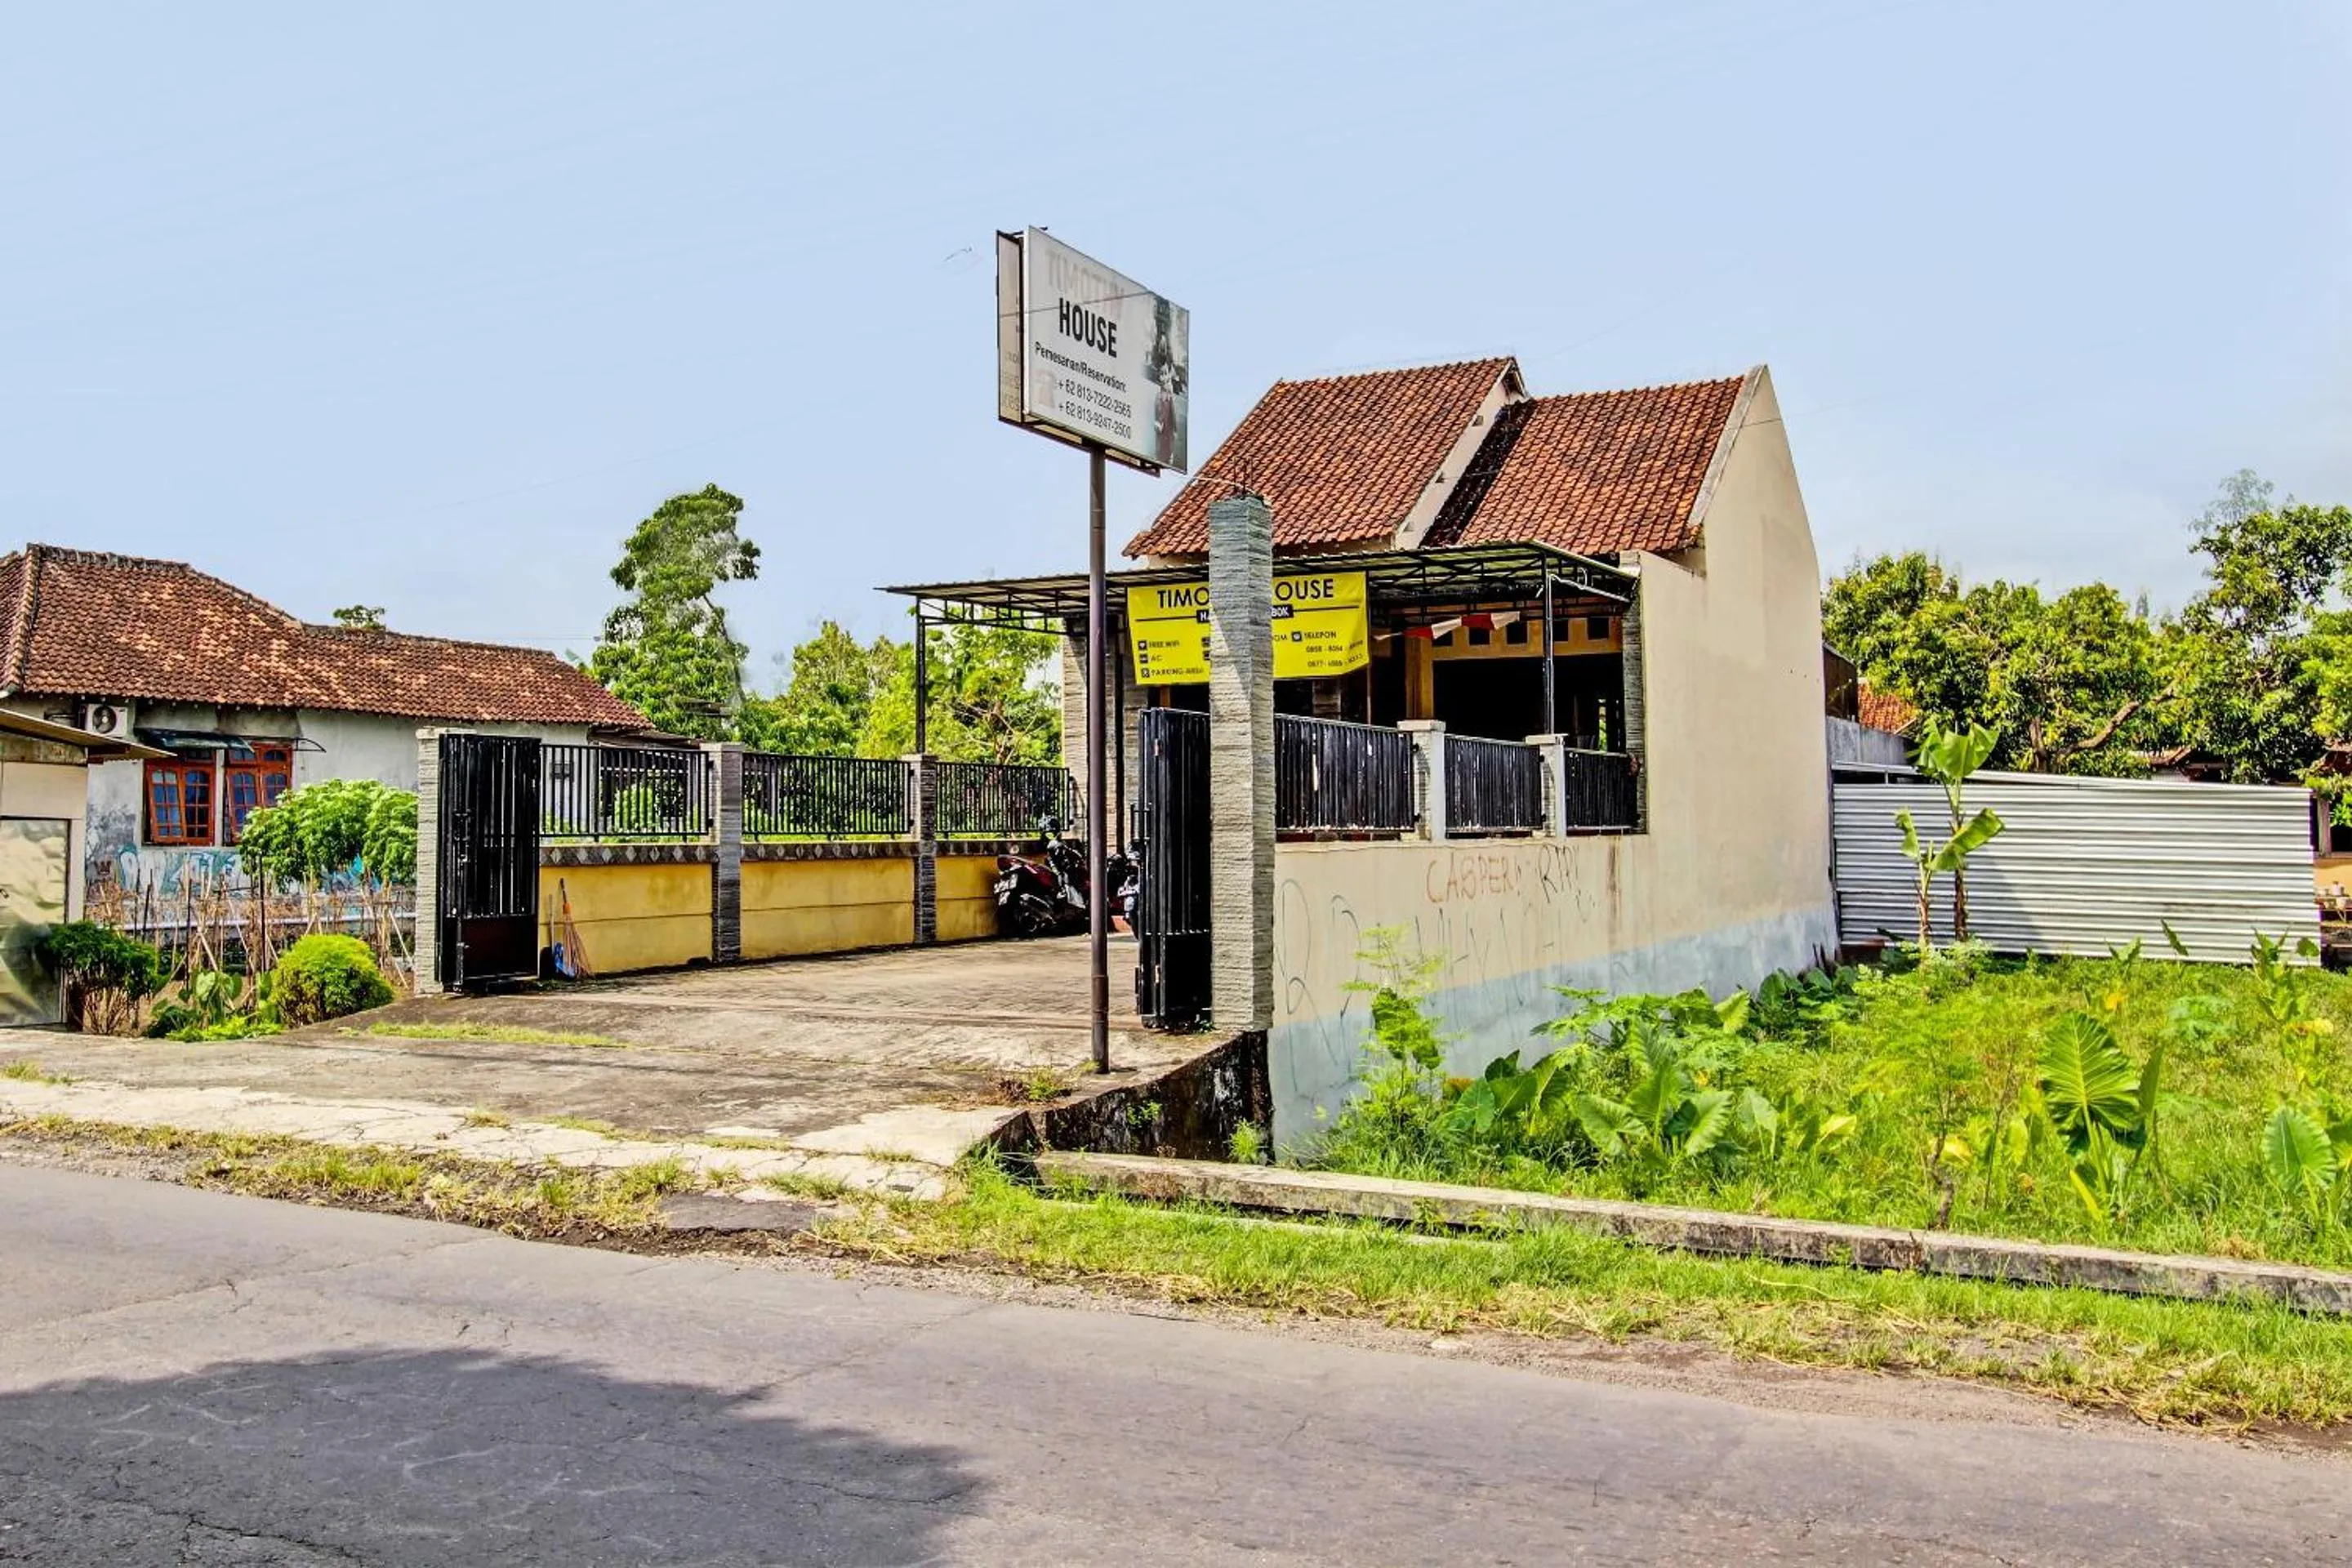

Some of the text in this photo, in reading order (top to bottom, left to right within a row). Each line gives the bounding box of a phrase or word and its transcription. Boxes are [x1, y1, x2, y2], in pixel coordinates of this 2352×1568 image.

[1059, 297, 1117, 358] HOUSE
[1157, 578, 1334, 608] TIMO OUSE
[1304, 631, 1337, 639] TELEPON
